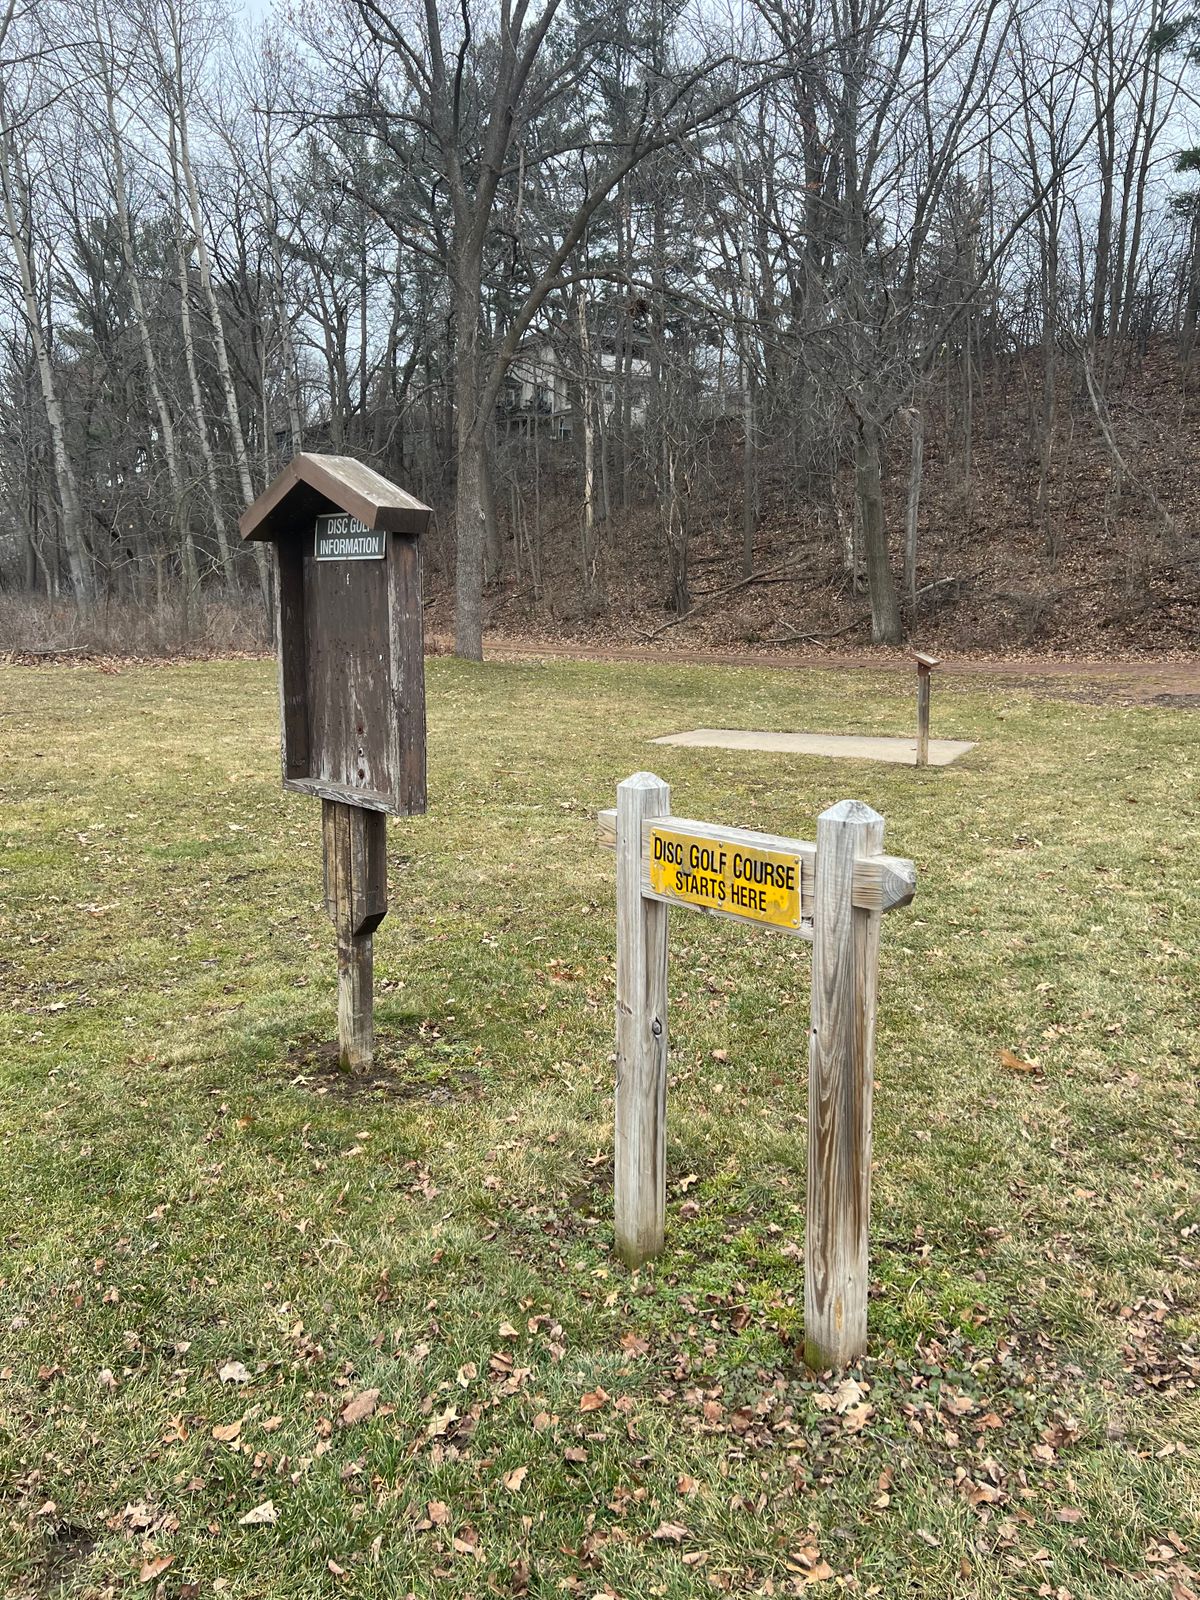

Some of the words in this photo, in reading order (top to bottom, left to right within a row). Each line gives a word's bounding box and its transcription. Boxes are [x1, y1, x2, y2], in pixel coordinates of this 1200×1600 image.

[327, 518, 348, 535] DISC
[320, 537, 379, 555] INFORMATION
[654, 836, 683, 866] DISC
[689, 844, 727, 874] GOLF
[733, 853, 795, 890] COURSE
[675, 871, 726, 901] STARTS
[731, 883, 767, 912] HERE
